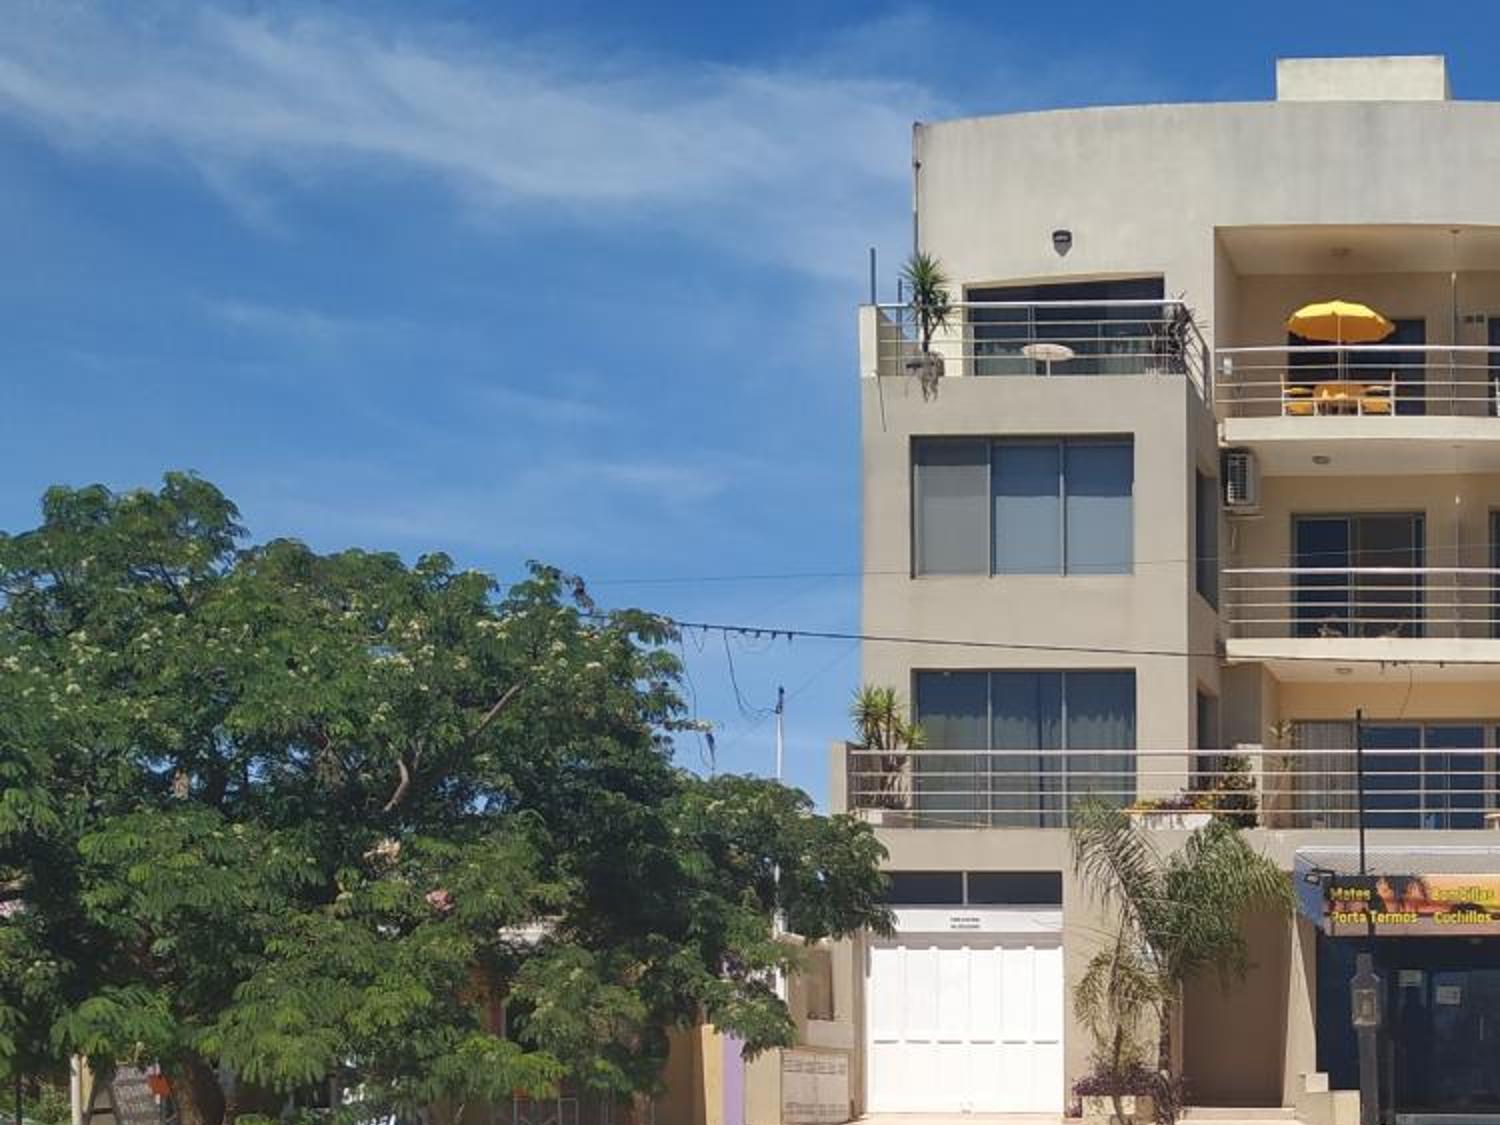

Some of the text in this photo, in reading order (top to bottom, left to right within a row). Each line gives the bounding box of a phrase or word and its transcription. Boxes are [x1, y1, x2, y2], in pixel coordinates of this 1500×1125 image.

[1330, 886, 1372, 901] Mates
[1331, 910, 1418, 925] Porta Termos
[1433, 910, 1493, 925] Cuchillos
